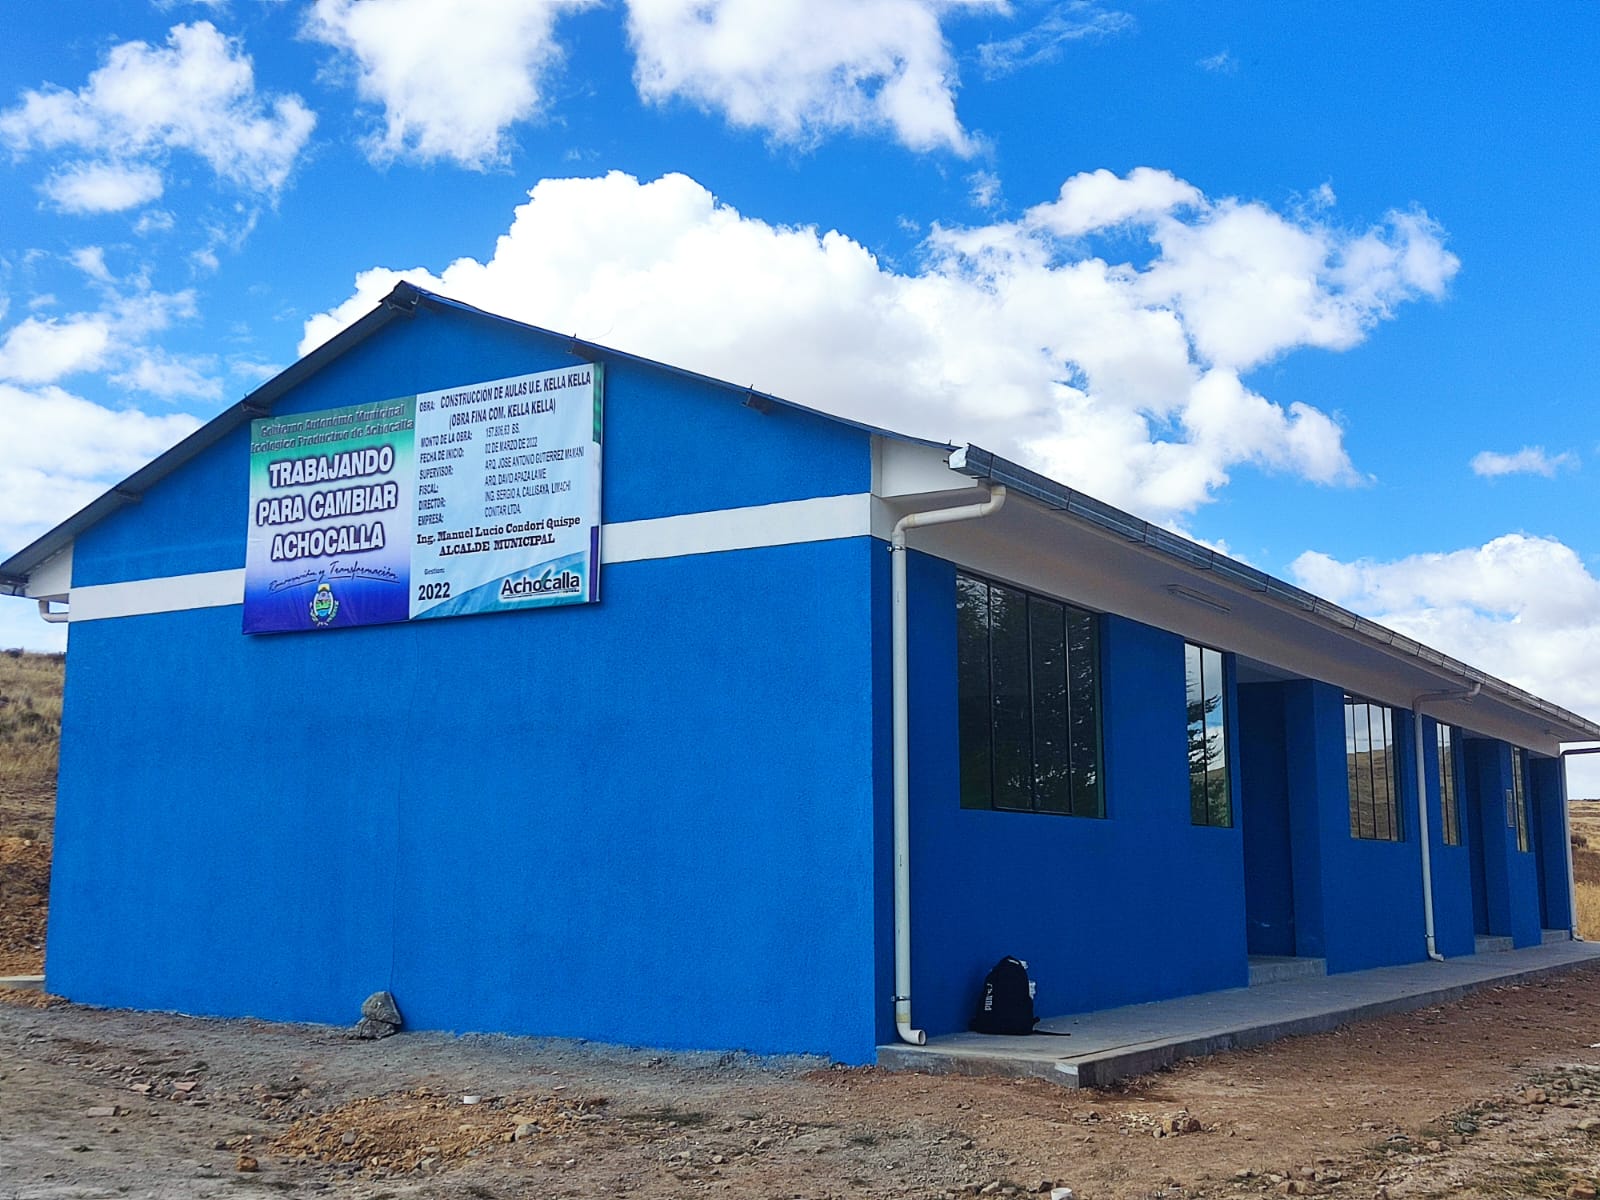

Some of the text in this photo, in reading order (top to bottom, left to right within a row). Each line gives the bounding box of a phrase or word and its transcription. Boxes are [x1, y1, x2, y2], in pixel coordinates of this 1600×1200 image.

[419, 401, 436, 412] OBRA:
[494, 386, 503, 400] DE
[504, 382, 527, 400] AULAS
[528, 379, 543, 395] U.E.
[543, 376, 566, 392] KELLA
[567, 371, 591, 387] KELLA
[356, 403, 405, 423] Municipal
[449, 398, 556, 430] (OBRA FINA COM. KELLA KELLA)
[351, 426, 364, 438] de
[365, 419, 415, 436] Achocalla
[420, 435, 440, 448] MONTO
[440, 434, 448, 445] DE
[448, 433, 456, 444] LA
[420, 450, 437, 464] FECHA
[437, 449, 446, 461] DE
[491, 442, 499, 453] DE
[499, 439, 518, 452] MARZO
[518, 438, 526, 450] DE
[269, 446, 395, 488] TRABAJANDO
[257, 482, 398, 526] PARA CAMBIAR
[270, 522, 386, 562] ACHOCALLA
[416, 516, 581, 545] Ing. Manuel Lucio Condori Quispe
[439, 533, 555, 557] ALCALDE MUNICIPAL
[418, 581, 451, 601] 2022
[501, 571, 580, 595] Achocalla
